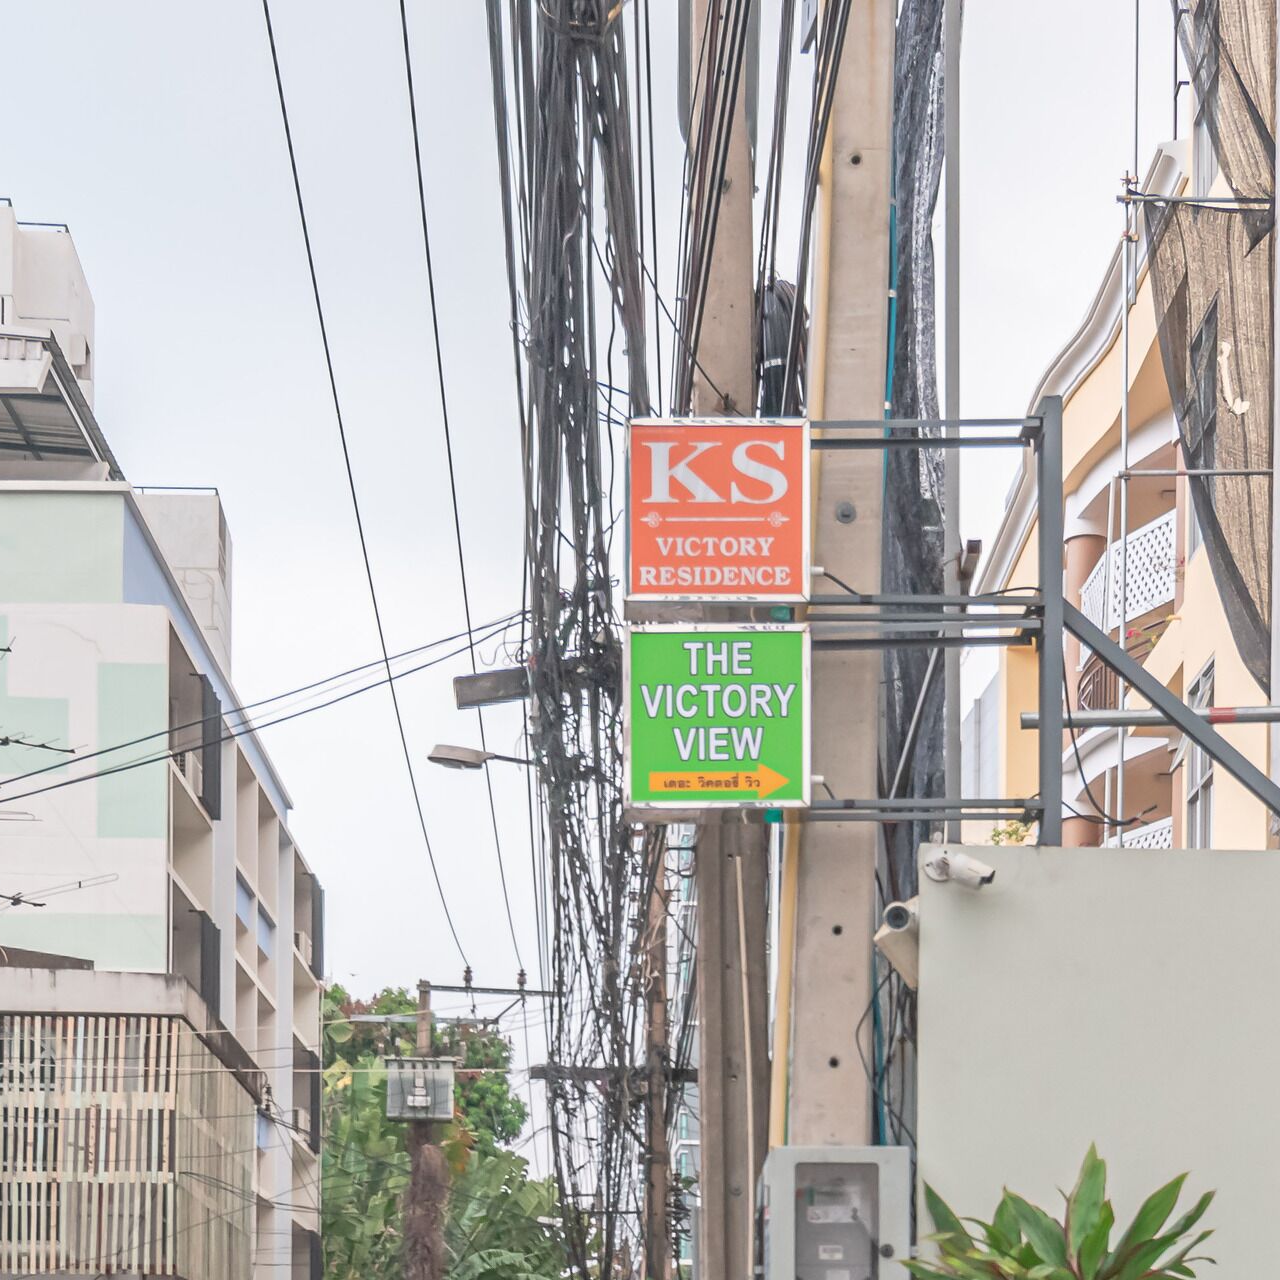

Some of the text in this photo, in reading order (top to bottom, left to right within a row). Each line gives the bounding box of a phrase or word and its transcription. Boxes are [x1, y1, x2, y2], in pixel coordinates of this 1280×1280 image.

[641, 439, 789, 505] KS
[655, 536, 775, 557] VICTORY
[639, 566, 791, 587] RESIDENCE
[682, 640, 754, 676] THE
[639, 682, 797, 719] VICTORY
[672, 725, 765, 762] VIEW
[663, 779, 692, 789] เดอะ
[744, 775, 762, 789] วิว
